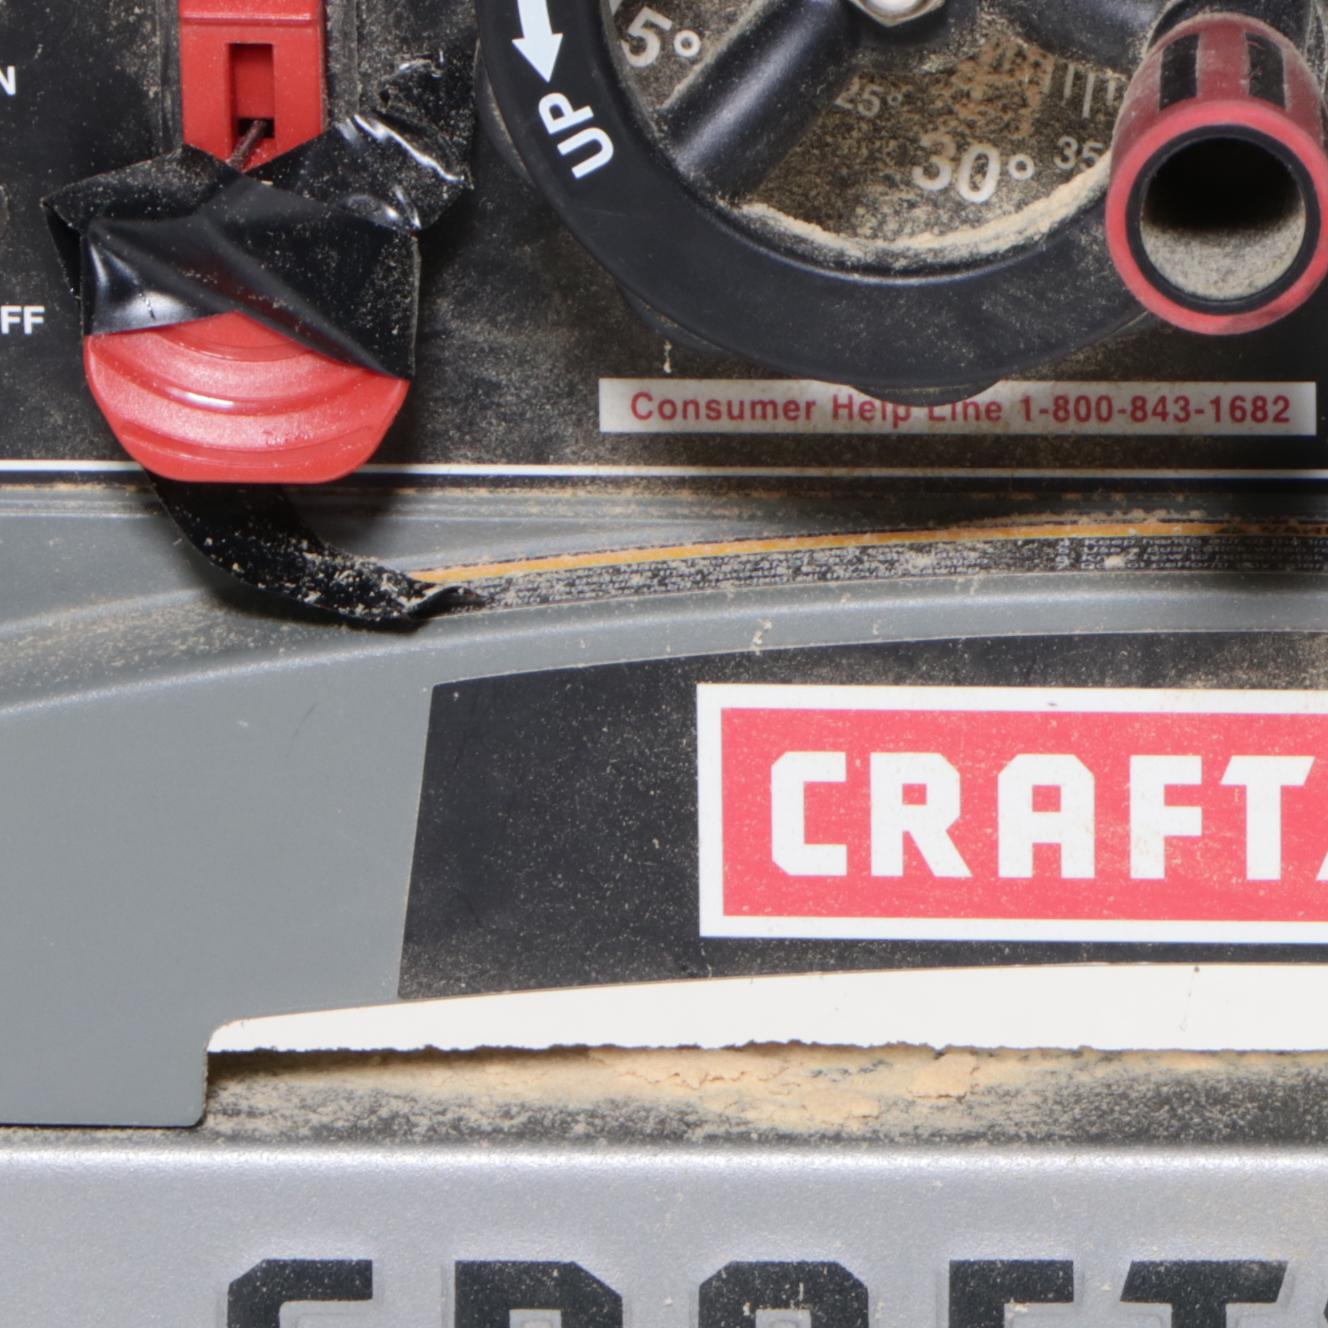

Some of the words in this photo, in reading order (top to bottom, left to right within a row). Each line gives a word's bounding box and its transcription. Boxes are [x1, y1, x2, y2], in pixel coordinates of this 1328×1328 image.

[538, 92, 614, 179] UP
[0, 305, 45, 335] FF
[630, 391, 815, 422] Consumer
[831, 394, 911, 430] Help
[1019, 394, 1291, 424] 1-800-843-1682
